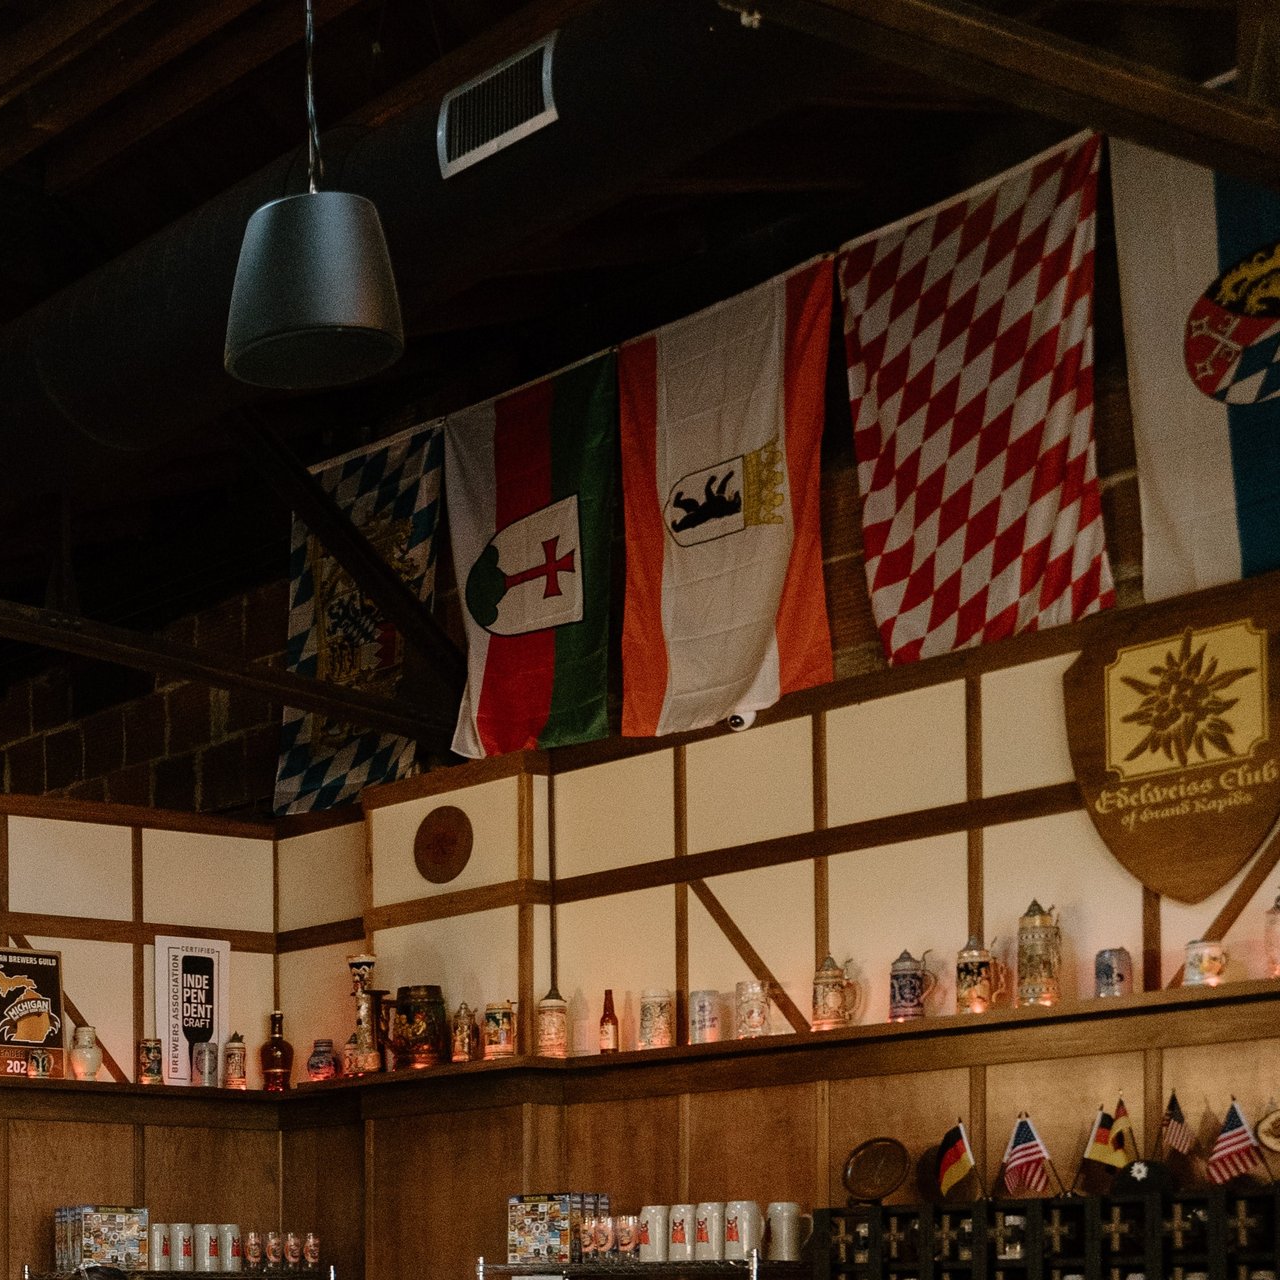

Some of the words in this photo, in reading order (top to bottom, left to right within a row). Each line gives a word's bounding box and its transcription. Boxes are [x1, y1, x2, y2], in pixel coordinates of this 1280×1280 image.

[1095, 777, 1214, 814] Edelweiss
[1219, 759, 1278, 790] Club
[180, 946, 215, 954] CERTIFIED
[8, 955, 37, 964] BREWERS
[38, 958, 57, 966] GUILD
[183, 973, 209, 989] INDE
[183, 988, 206, 1003] PEN
[8, 1000, 49, 1021] MICHIGAN
[183, 1003, 212, 1018] DENT
[183, 1018, 210, 1028] CRAFT
[7, 1060, 27, 1074] 202
